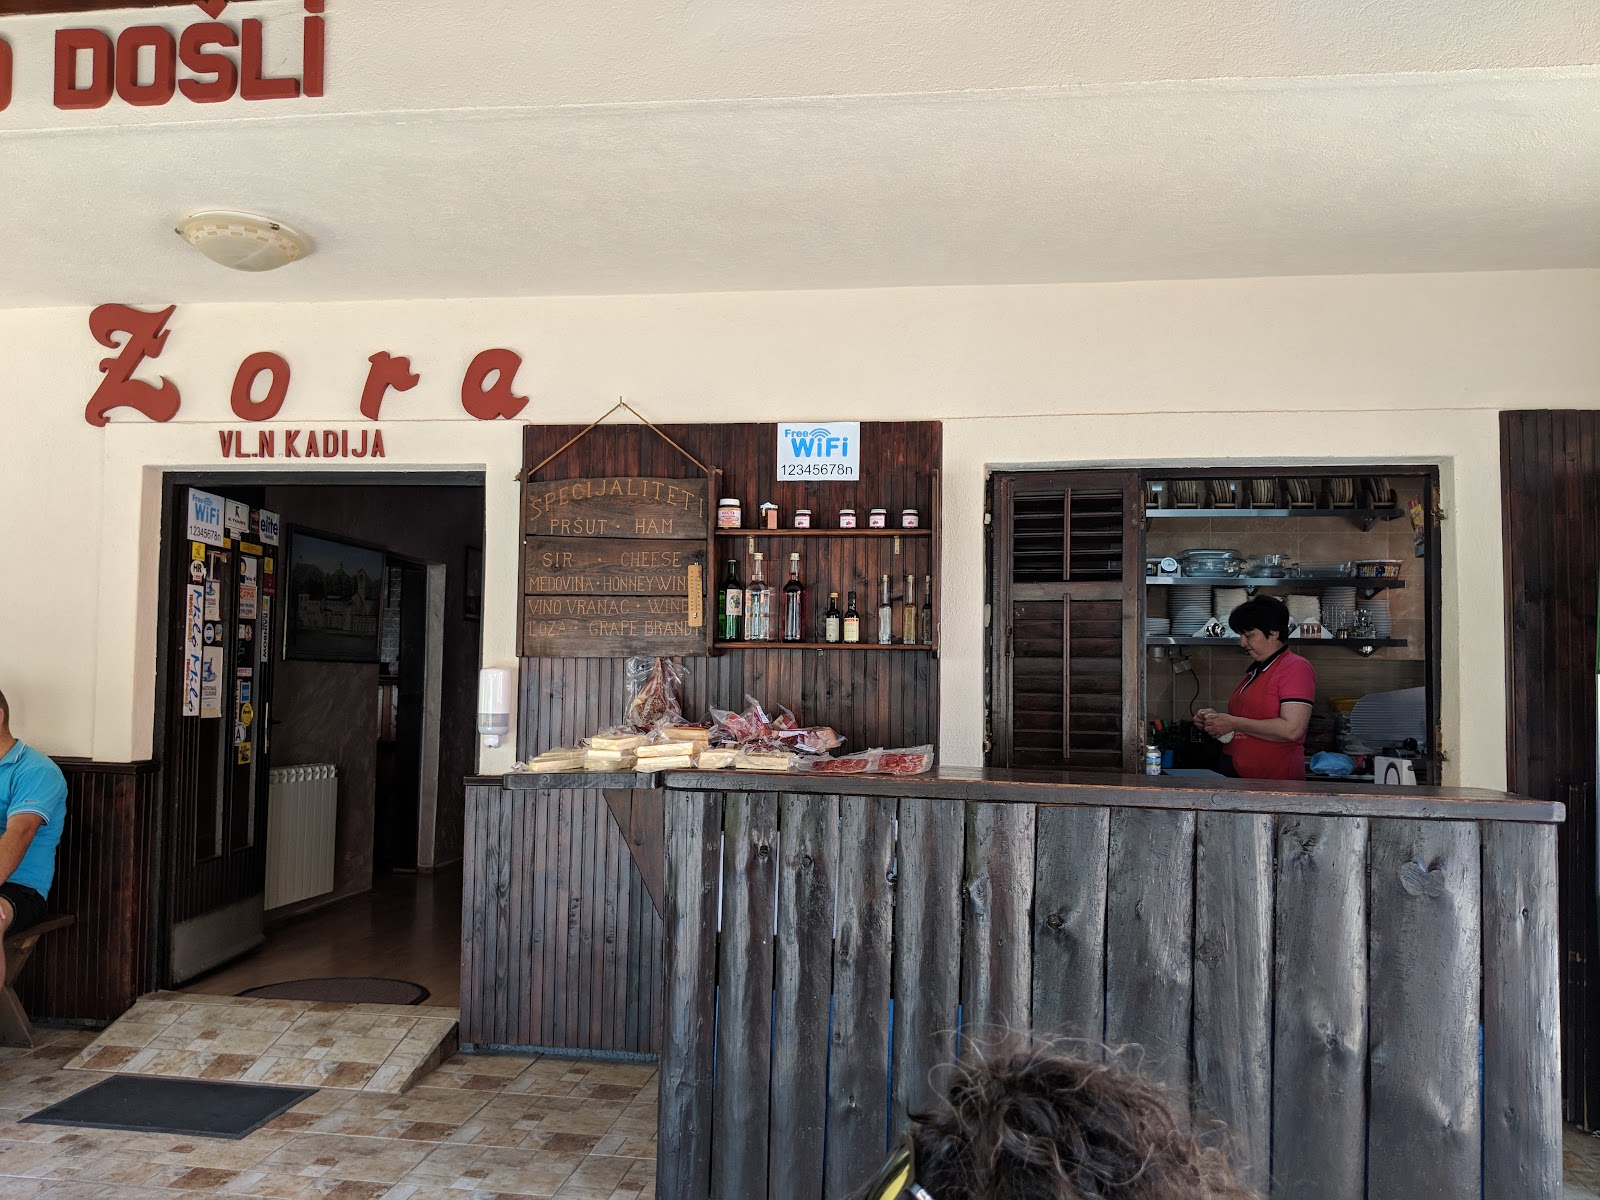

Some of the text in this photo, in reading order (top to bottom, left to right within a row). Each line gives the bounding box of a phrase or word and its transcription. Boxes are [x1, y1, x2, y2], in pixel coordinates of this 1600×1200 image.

[85, 302, 529, 427] Zora
[784, 428, 809, 438] Free
[285, 429, 386, 458] KADIJA
[791, 437, 848, 457] WiFi
[781, 463, 853, 476] 12345678n
[530, 479, 704, 522] SPECIJALITETI
[194, 503, 220, 526] WiFi
[260, 515, 279, 535] elite
[550, 517, 673, 535] PRŠUT HAM
[193, 563, 202, 573] HR
[542, 551, 682, 568] SIR CHEESE
[528, 576, 593, 592] MEDOVINA
[528, 599, 562, 615] VINO
[566, 599, 630, 615] VRANAC
[528, 620, 566, 636] LOZA
[589, 620, 639, 636] GRAPE
